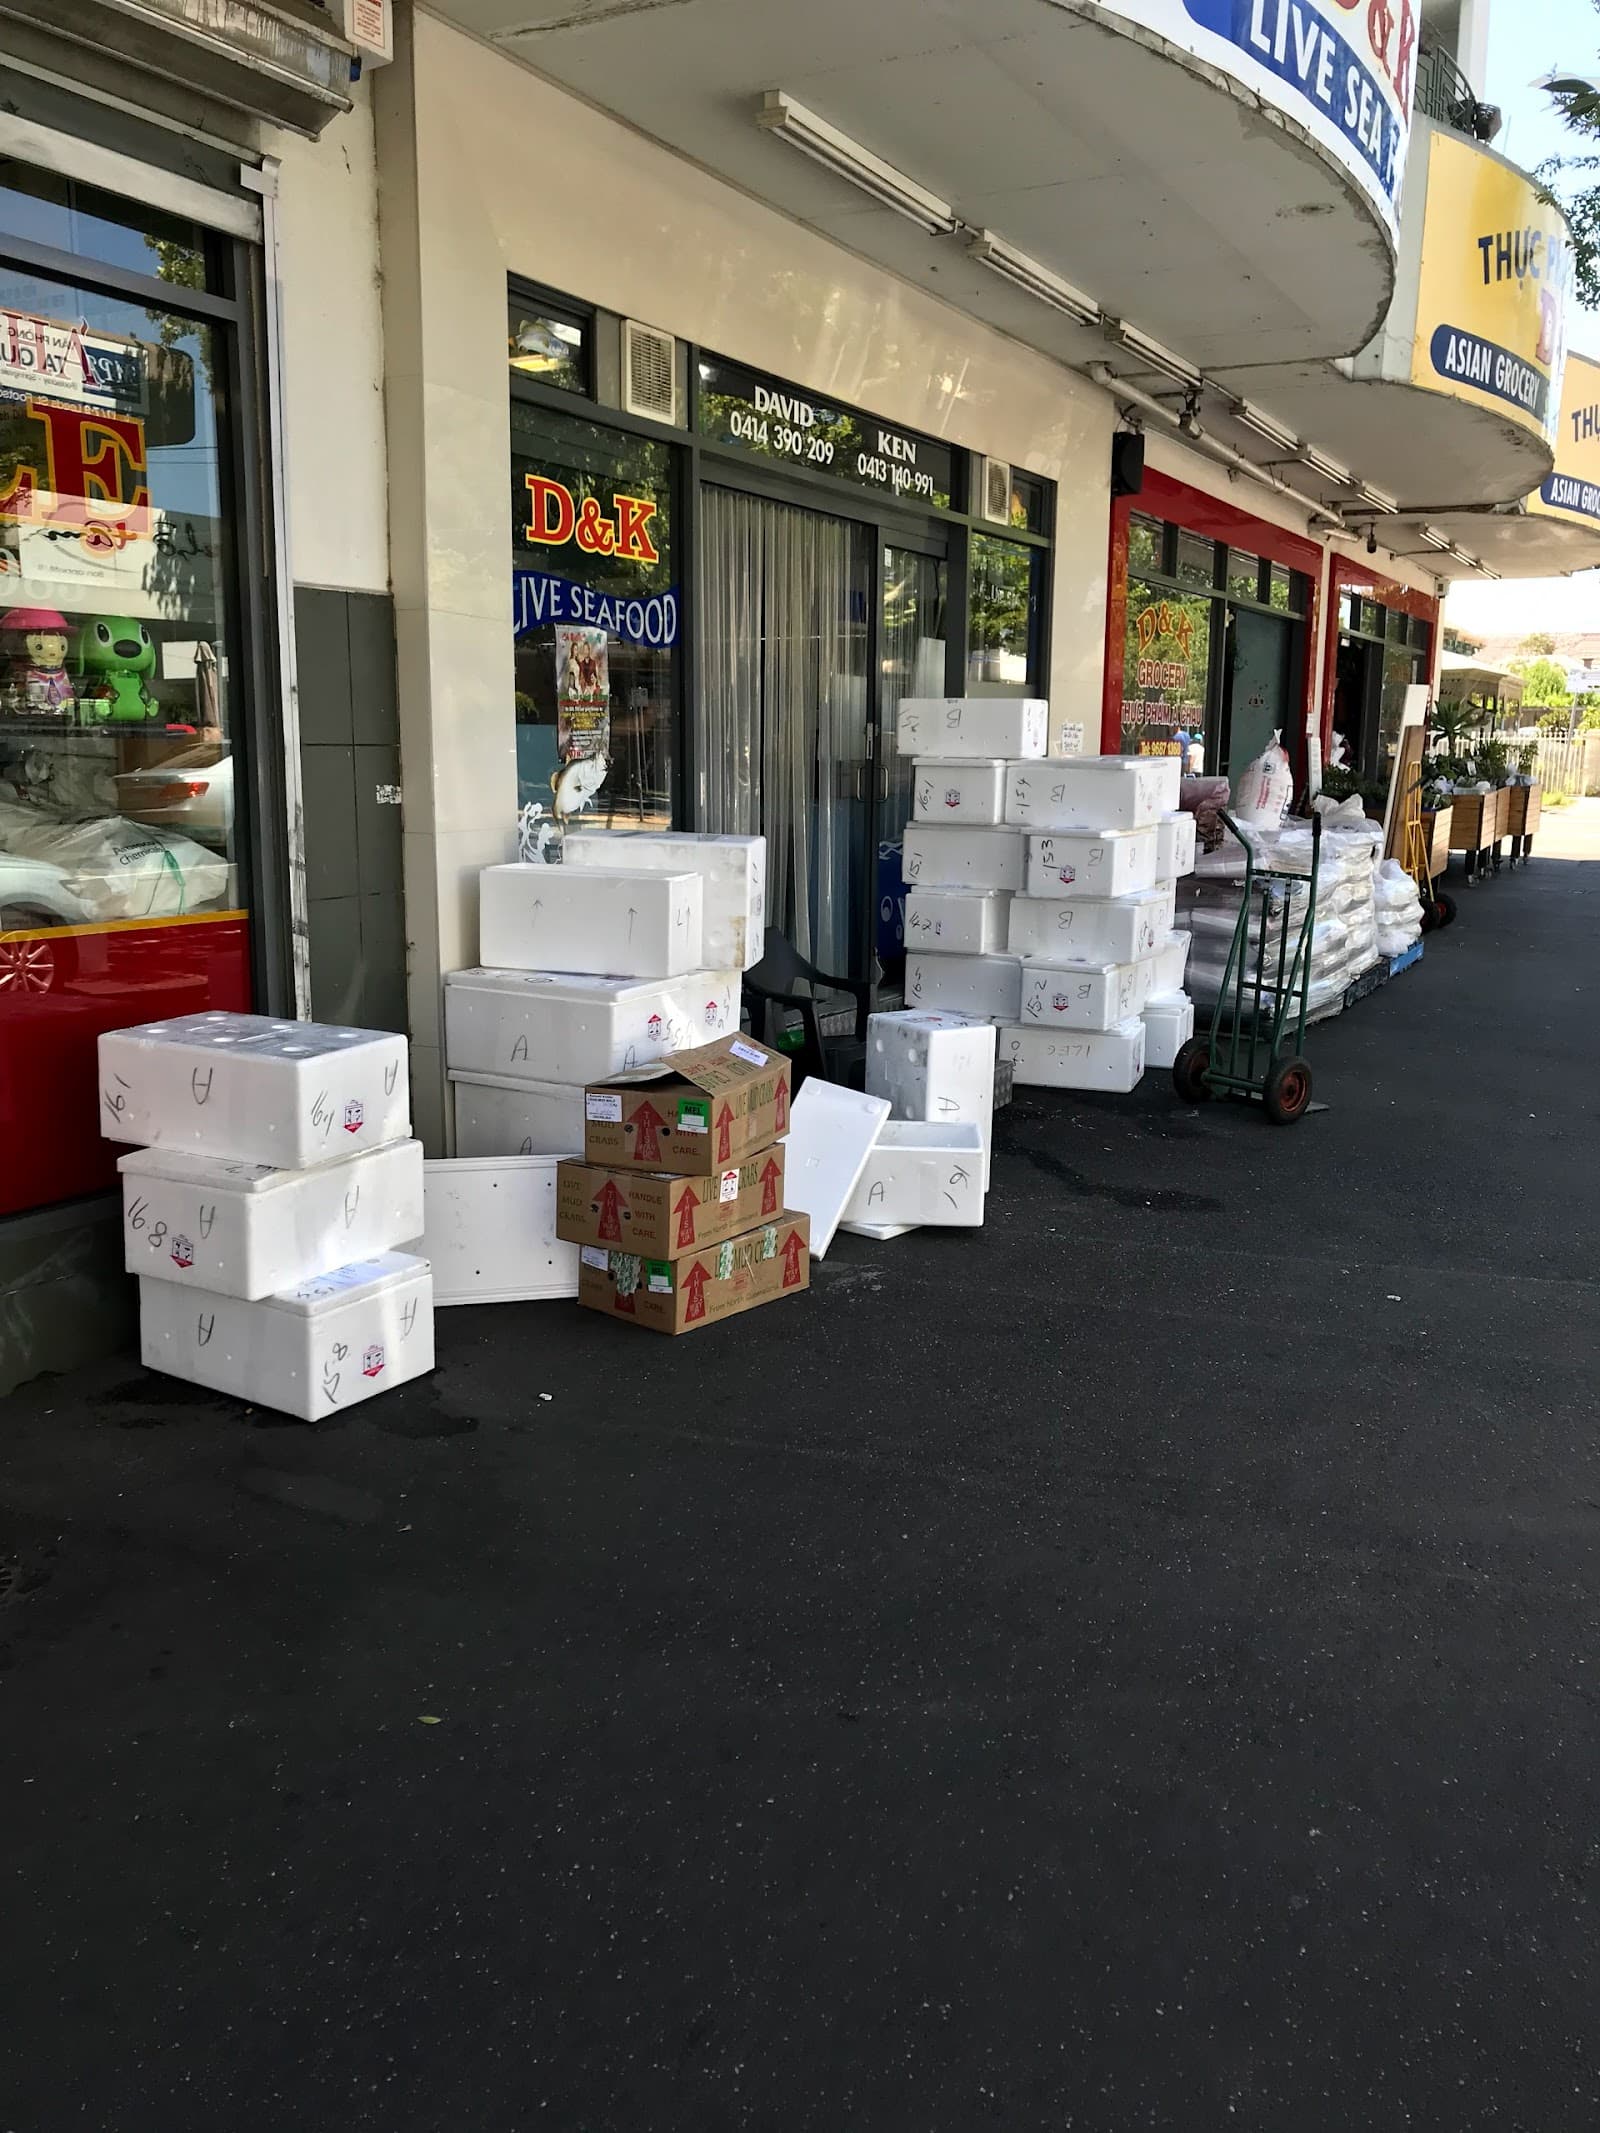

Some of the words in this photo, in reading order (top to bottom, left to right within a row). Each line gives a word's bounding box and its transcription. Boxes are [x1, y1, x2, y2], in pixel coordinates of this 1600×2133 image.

[1250, 0, 1336, 104] LIVE
[1445, 334, 1492, 385] ASIAN
[1495, 354, 1540, 410] GROCERY
[754, 385, 816, 428] DAVID
[730, 411, 769, 445] 0414
[773, 425, 803, 455] 390
[806, 436, 835, 465] 209
[877, 430, 917, 464] KEN
[857, 453, 887, 482] 0413
[889, 463, 911, 490] 140
[914, 472, 934, 497] 991
[1550, 478, 1580, 507] ASIAN
[525, 473, 659, 564] D&K
[513, 577, 563, 635] IVE
[570, 585, 677, 645] SEAFOOD
[1137, 658, 1188, 691] GROCERY
